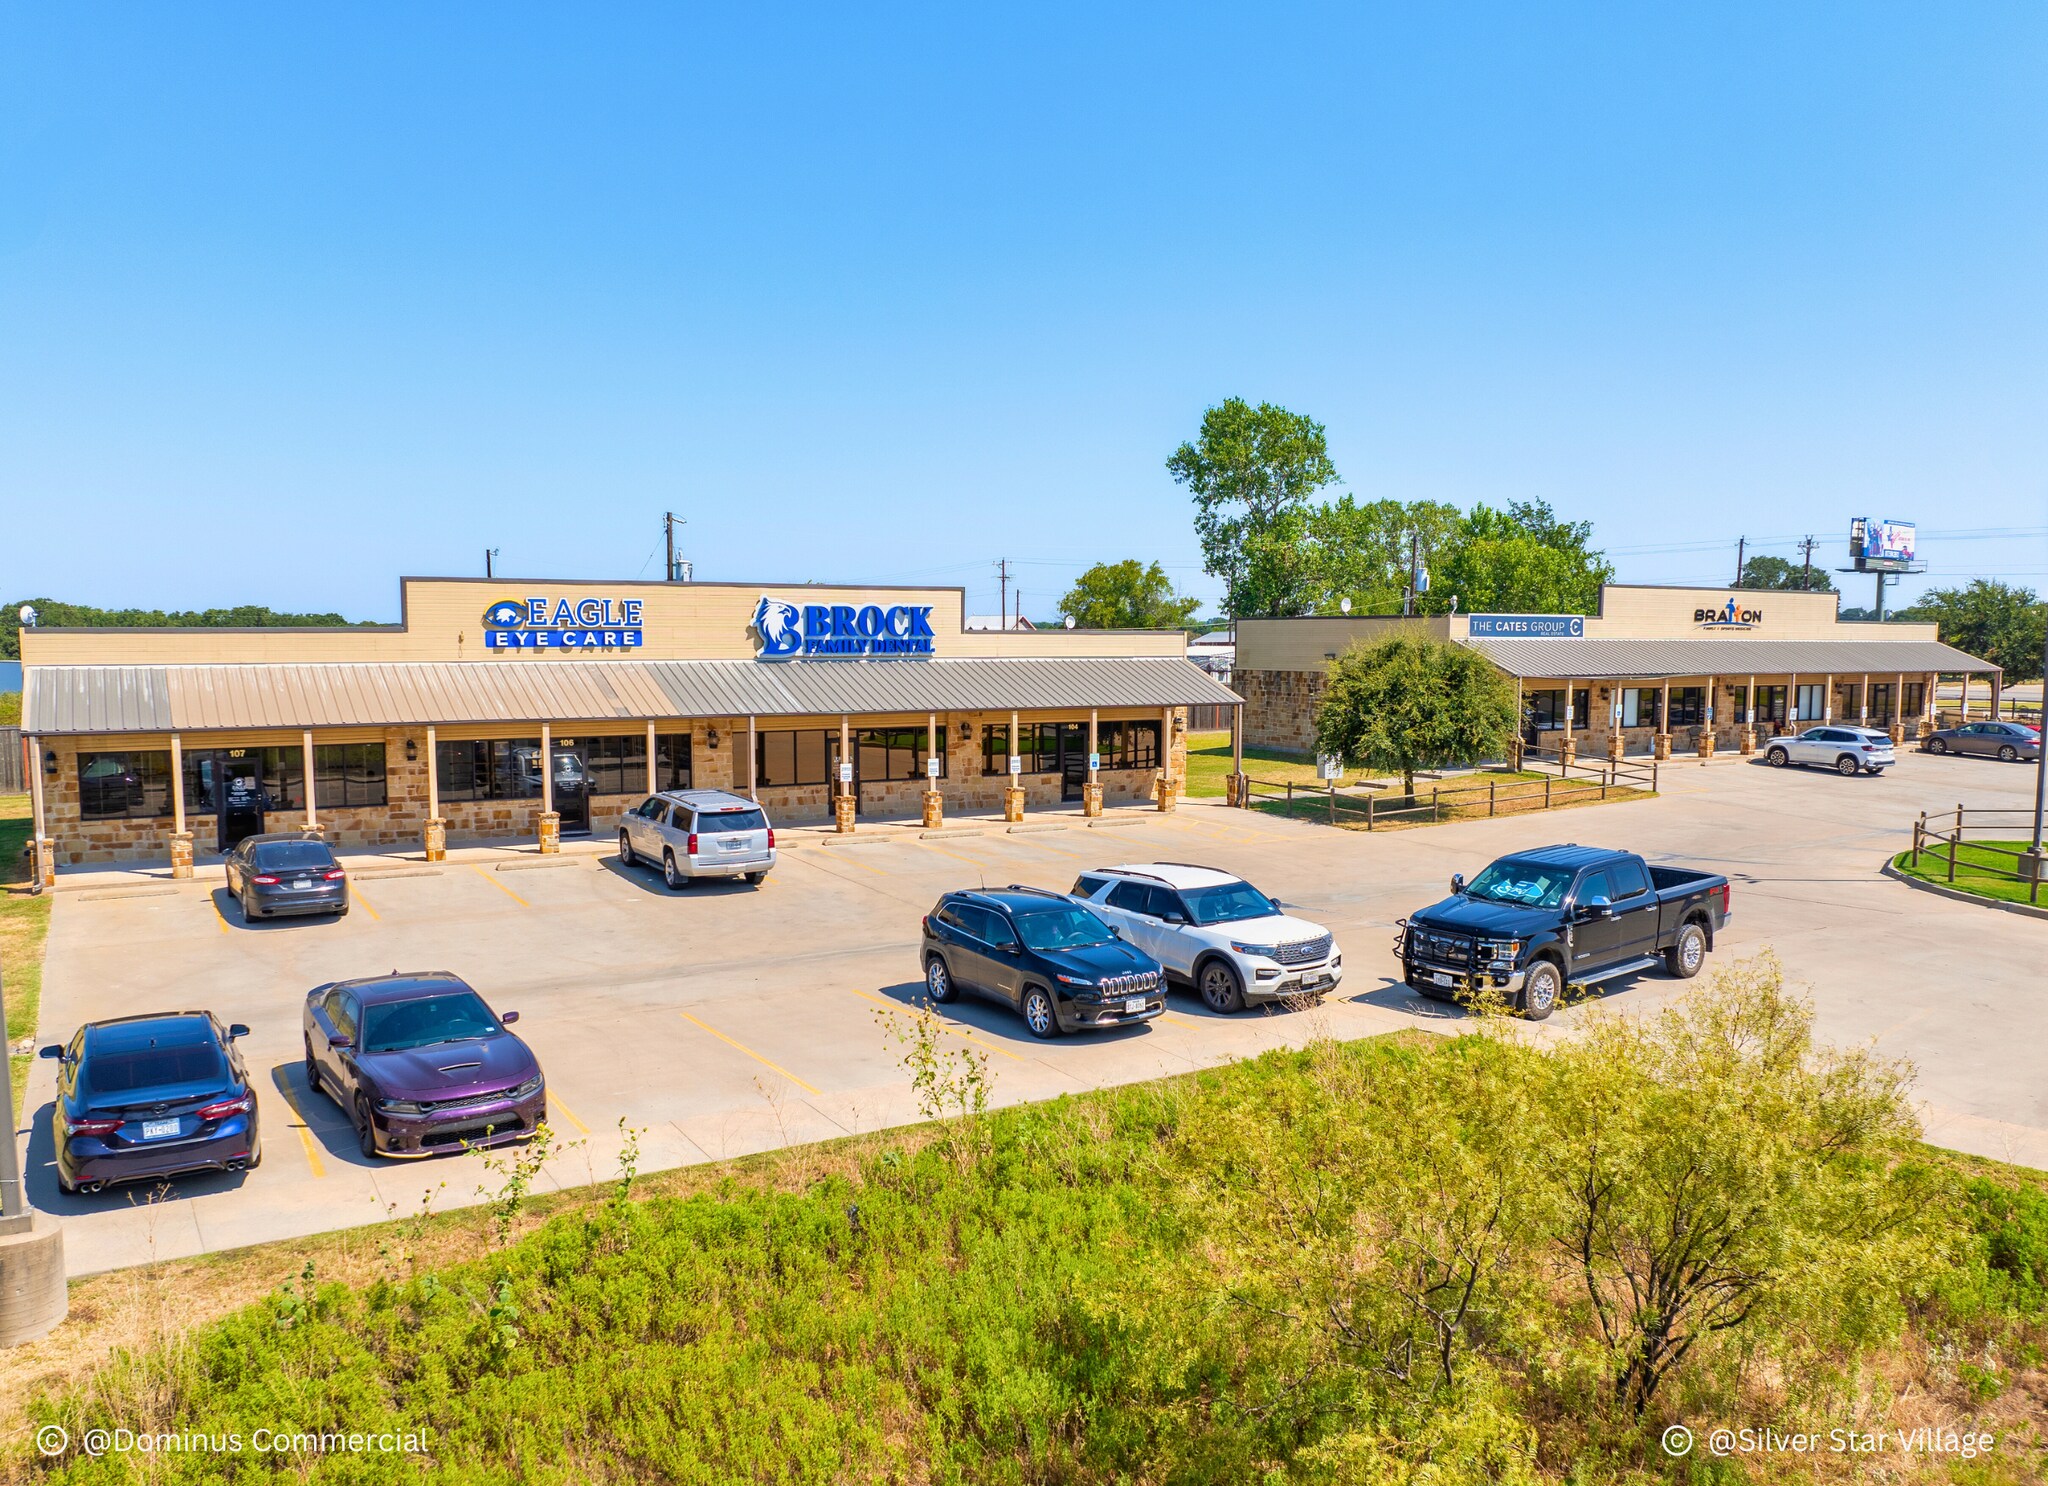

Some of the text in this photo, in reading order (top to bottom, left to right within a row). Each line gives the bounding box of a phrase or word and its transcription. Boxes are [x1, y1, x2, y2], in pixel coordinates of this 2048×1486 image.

[526, 598, 643, 627] EAGLE
[804, 605, 936, 637] BROCK
[1472, 621, 1565, 632] THE CATES GROUP
[495, 632, 635, 646] EYE CARE
[805, 638, 936, 654] FAMILY DENTAL
[560, 739, 575, 747] 106
[229, 749, 246, 758] 107
